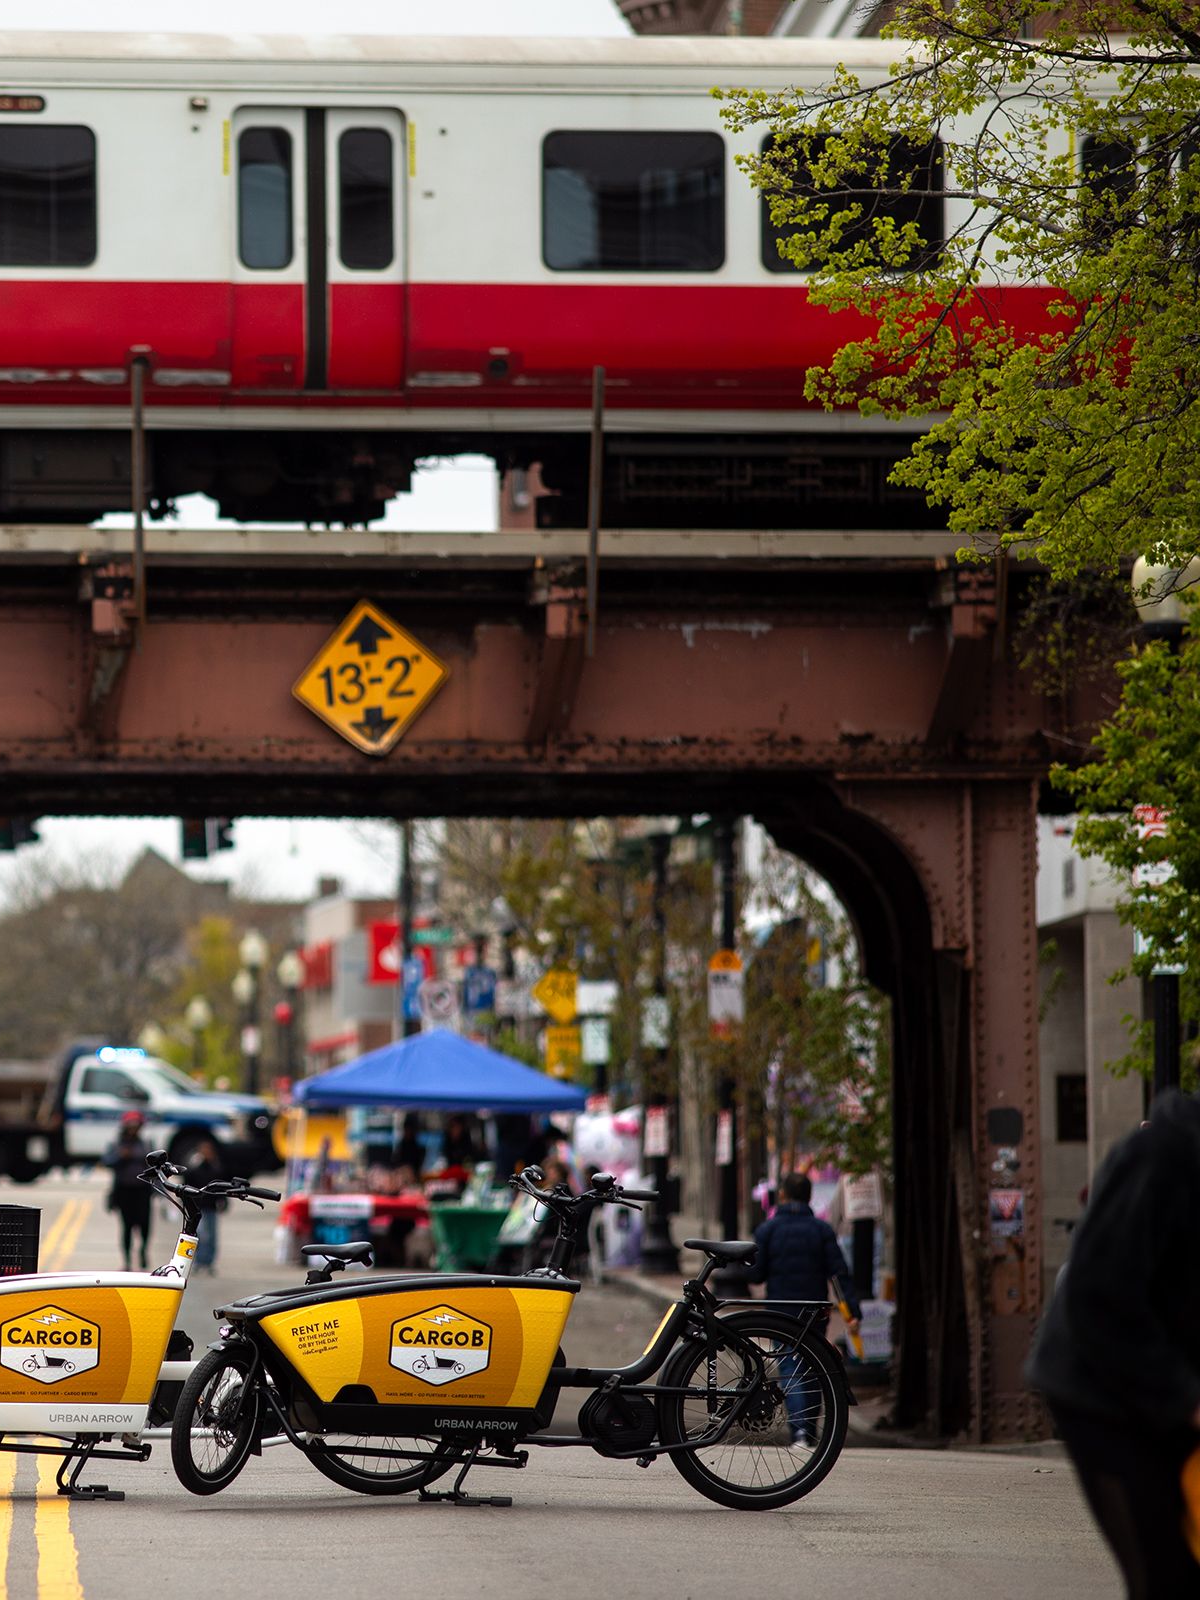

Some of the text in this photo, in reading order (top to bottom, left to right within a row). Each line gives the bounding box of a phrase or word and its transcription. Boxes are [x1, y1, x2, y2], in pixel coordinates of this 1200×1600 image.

[291, 1319, 340, 1336] RENT ME
[318, 1330, 336, 1338] HOUR
[49, 1414, 133, 1423] URBAN ARROW
[434, 1419, 518, 1430] URBAN ARROW
